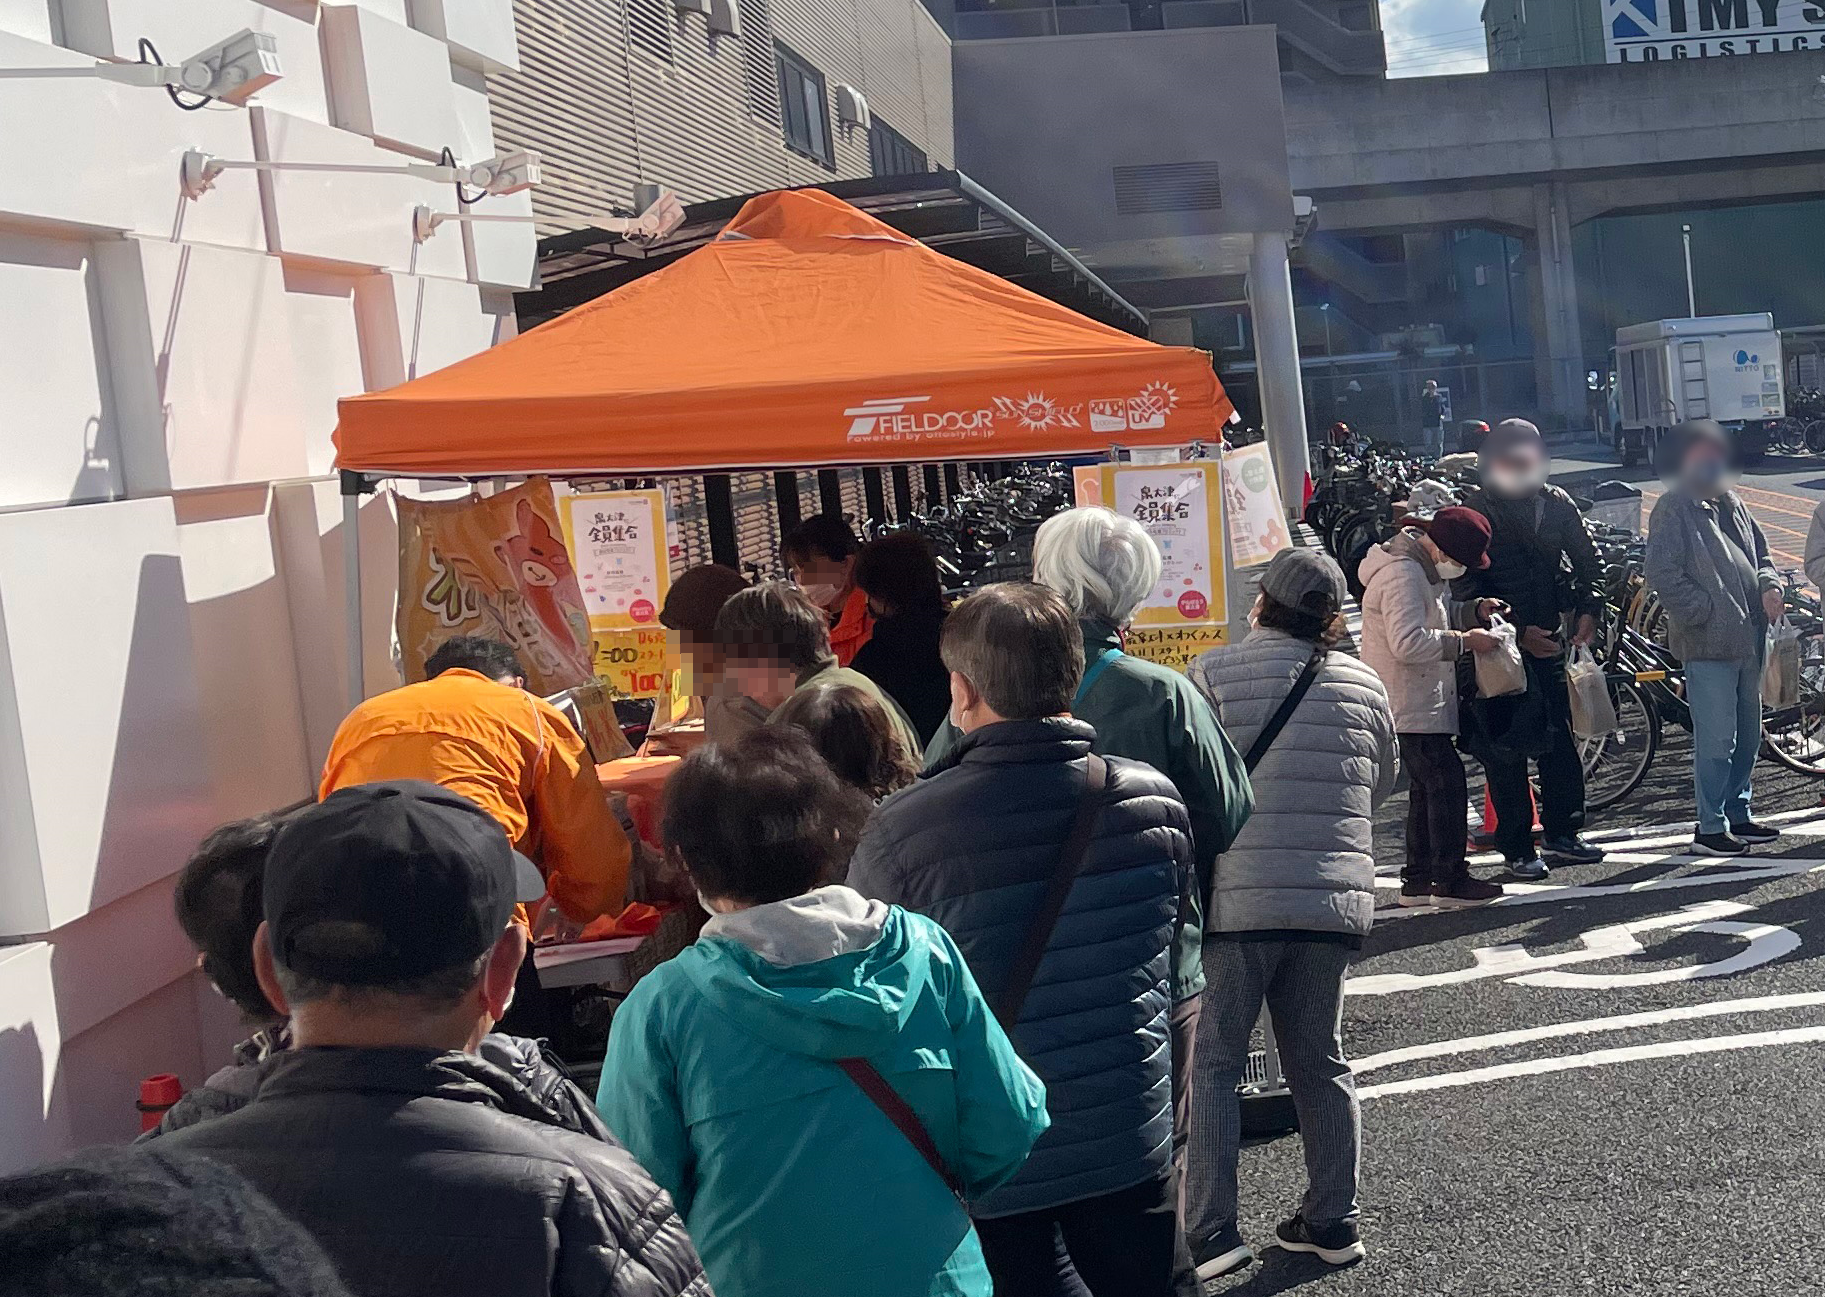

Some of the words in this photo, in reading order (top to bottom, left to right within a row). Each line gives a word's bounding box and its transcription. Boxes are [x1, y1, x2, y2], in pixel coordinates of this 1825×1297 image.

[1620, 36, 1825, 63] LOGISTIC
[878, 408, 994, 434] FIELDOOR
[847, 432, 901, 443] Powered
[905, 432, 921, 442] by
[1133, 501, 1190, 524] 全員集合
[588, 524, 638, 544] 全員集合
